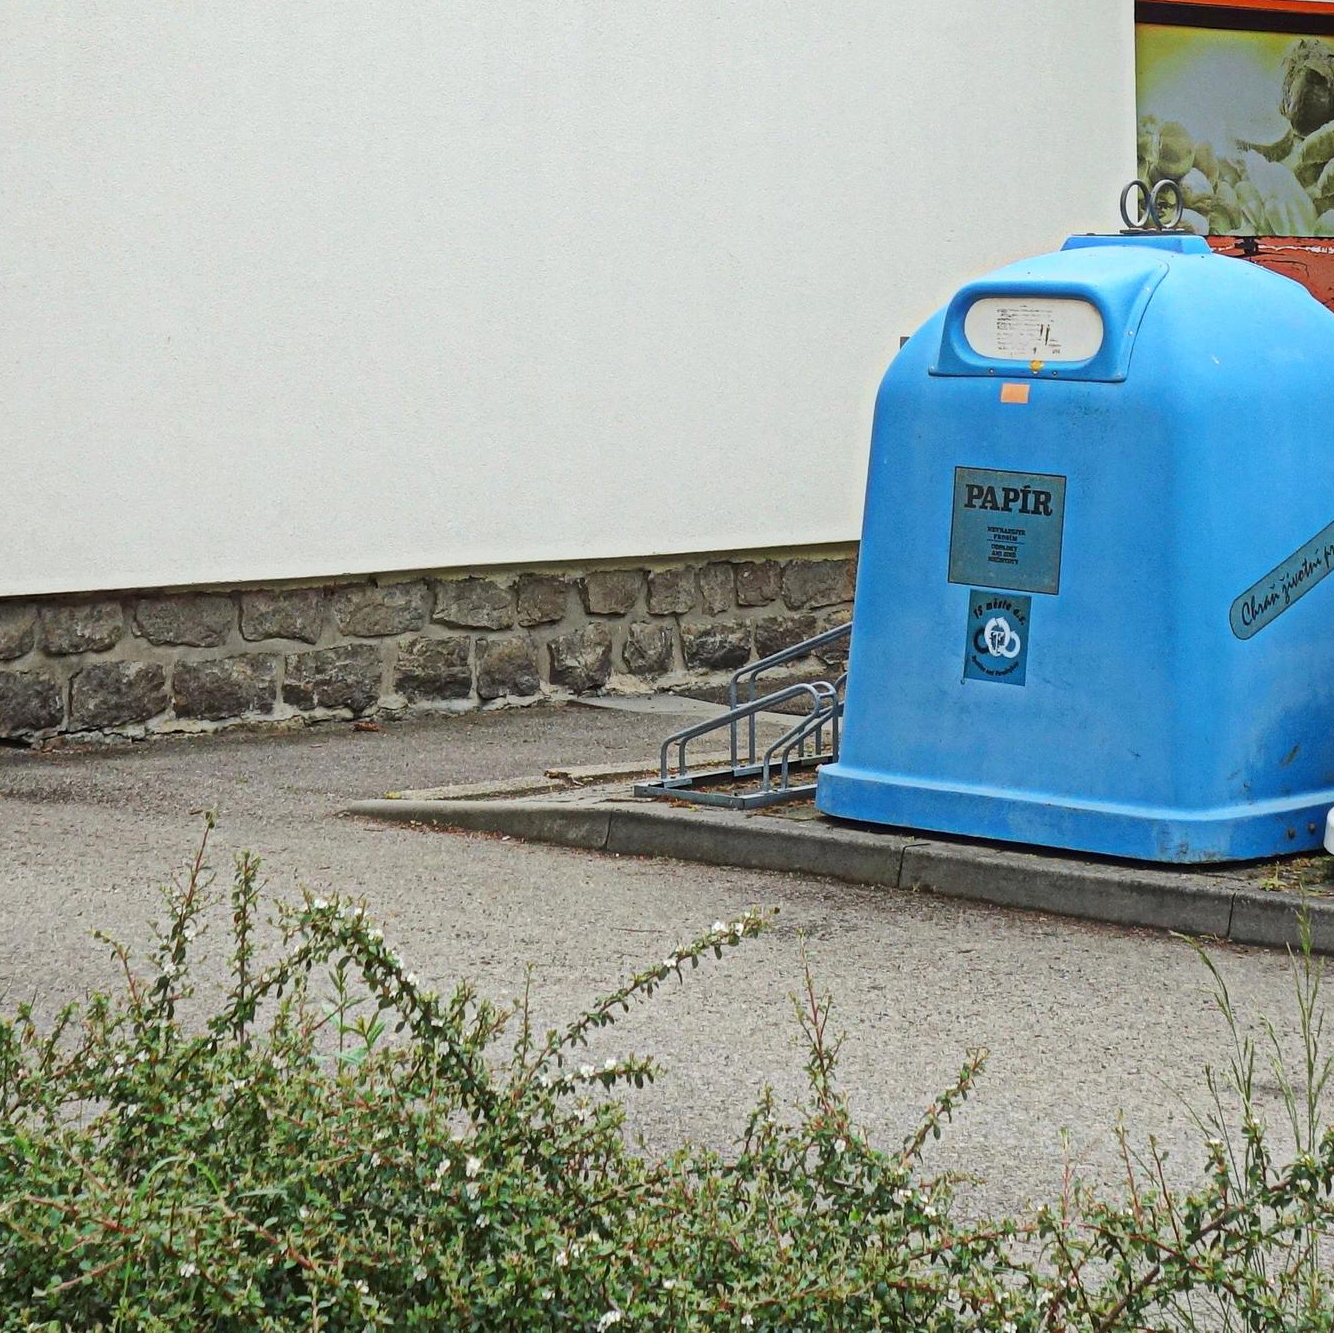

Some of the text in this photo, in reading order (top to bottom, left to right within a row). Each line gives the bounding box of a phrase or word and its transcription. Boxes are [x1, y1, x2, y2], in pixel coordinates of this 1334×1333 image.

[964, 484, 1053, 516] PAPÍR
[1241, 583, 1280, 626] Chraň
[1279, 547, 1322, 605] životní
